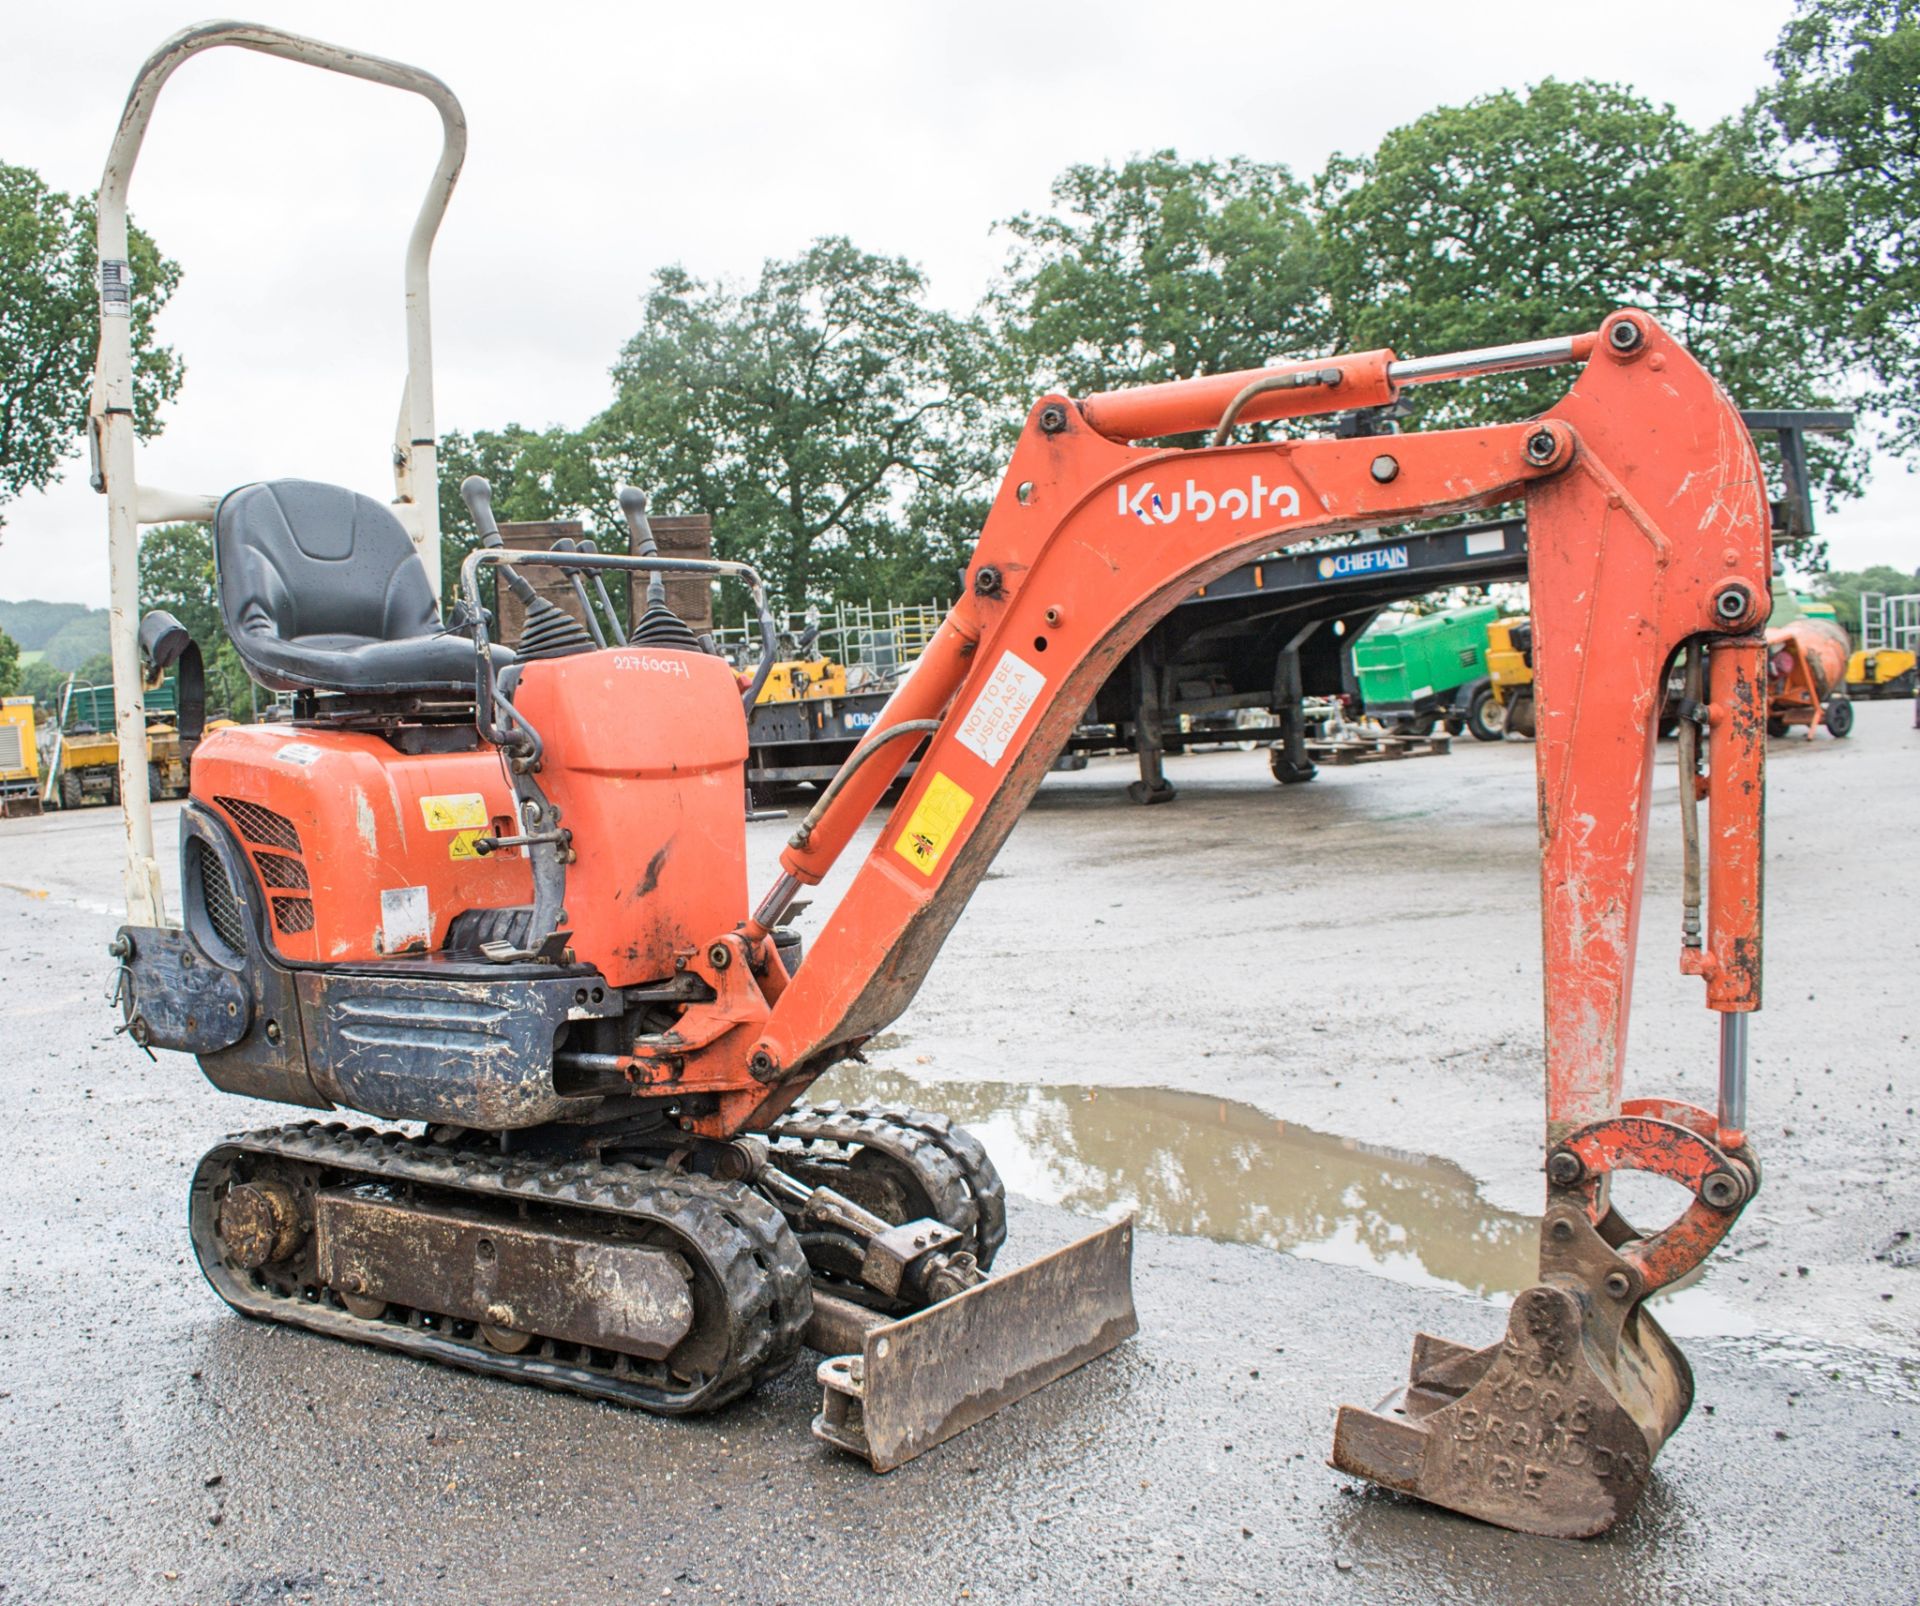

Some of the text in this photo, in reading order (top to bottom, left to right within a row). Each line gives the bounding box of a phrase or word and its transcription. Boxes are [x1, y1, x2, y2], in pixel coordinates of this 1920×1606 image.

[1117, 475, 1300, 526] Kubota
[1335, 546, 1408, 573] CHIEFTAIN
[613, 655, 690, 679] 22760071
[963, 660, 1014, 737] NOT TO BE
[975, 672, 1026, 746] USED AS A
[996, 692, 1031, 743] CRANE
[1453, 1407, 1638, 1483] BRANDON
